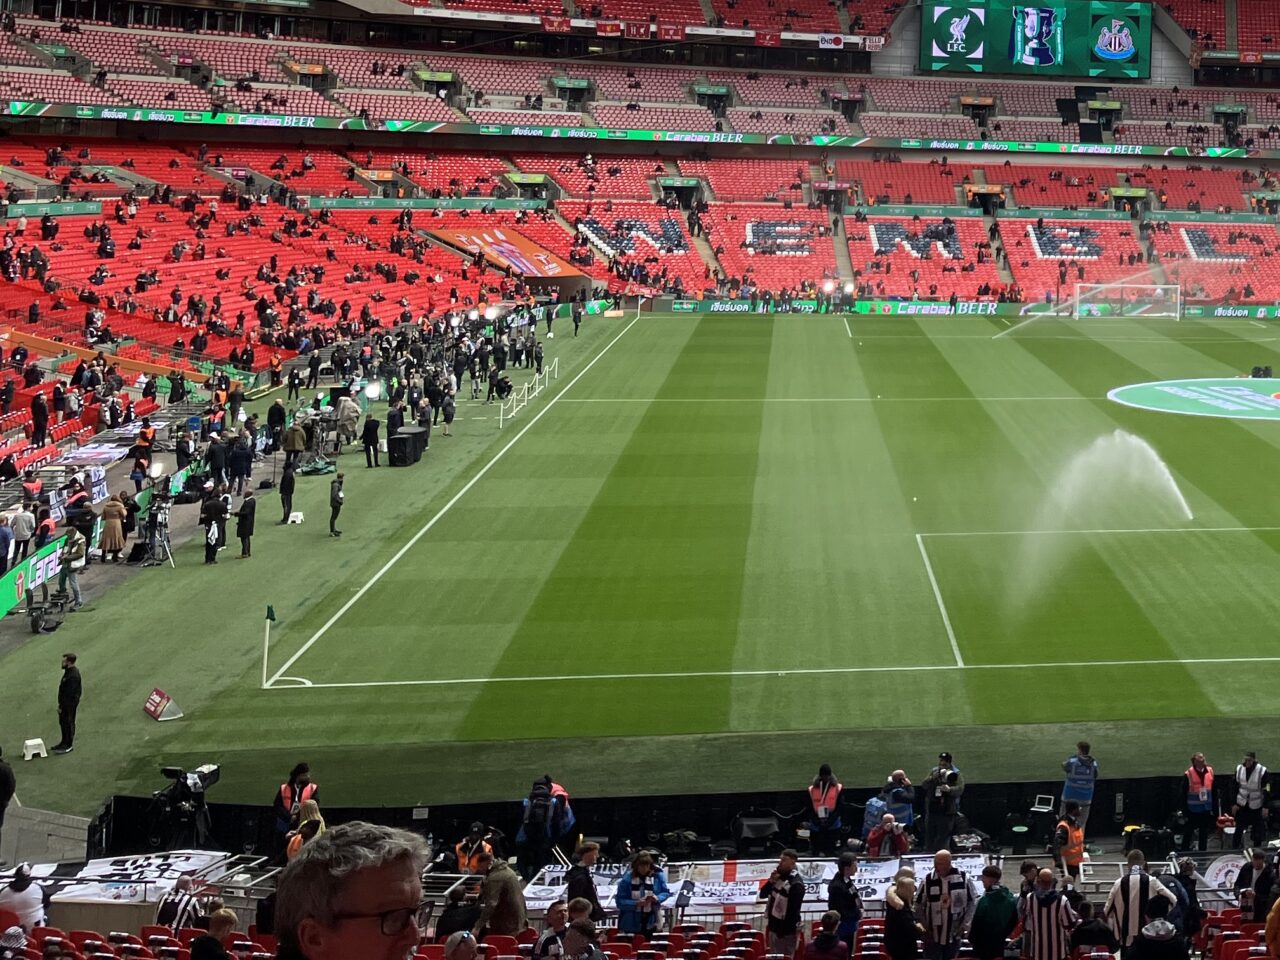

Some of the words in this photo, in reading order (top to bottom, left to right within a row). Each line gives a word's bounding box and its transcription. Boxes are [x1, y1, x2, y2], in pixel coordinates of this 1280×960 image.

[238, 115, 282, 127] Carabao
[284, 117, 315, 128] BEER
[665, 132, 709, 142] Carabao
[712, 133, 744, 143] BEER
[1071, 144, 1112, 154] Carabao
[1114, 145, 1143, 155] BEER
[958, 302, 997, 315] BEER
